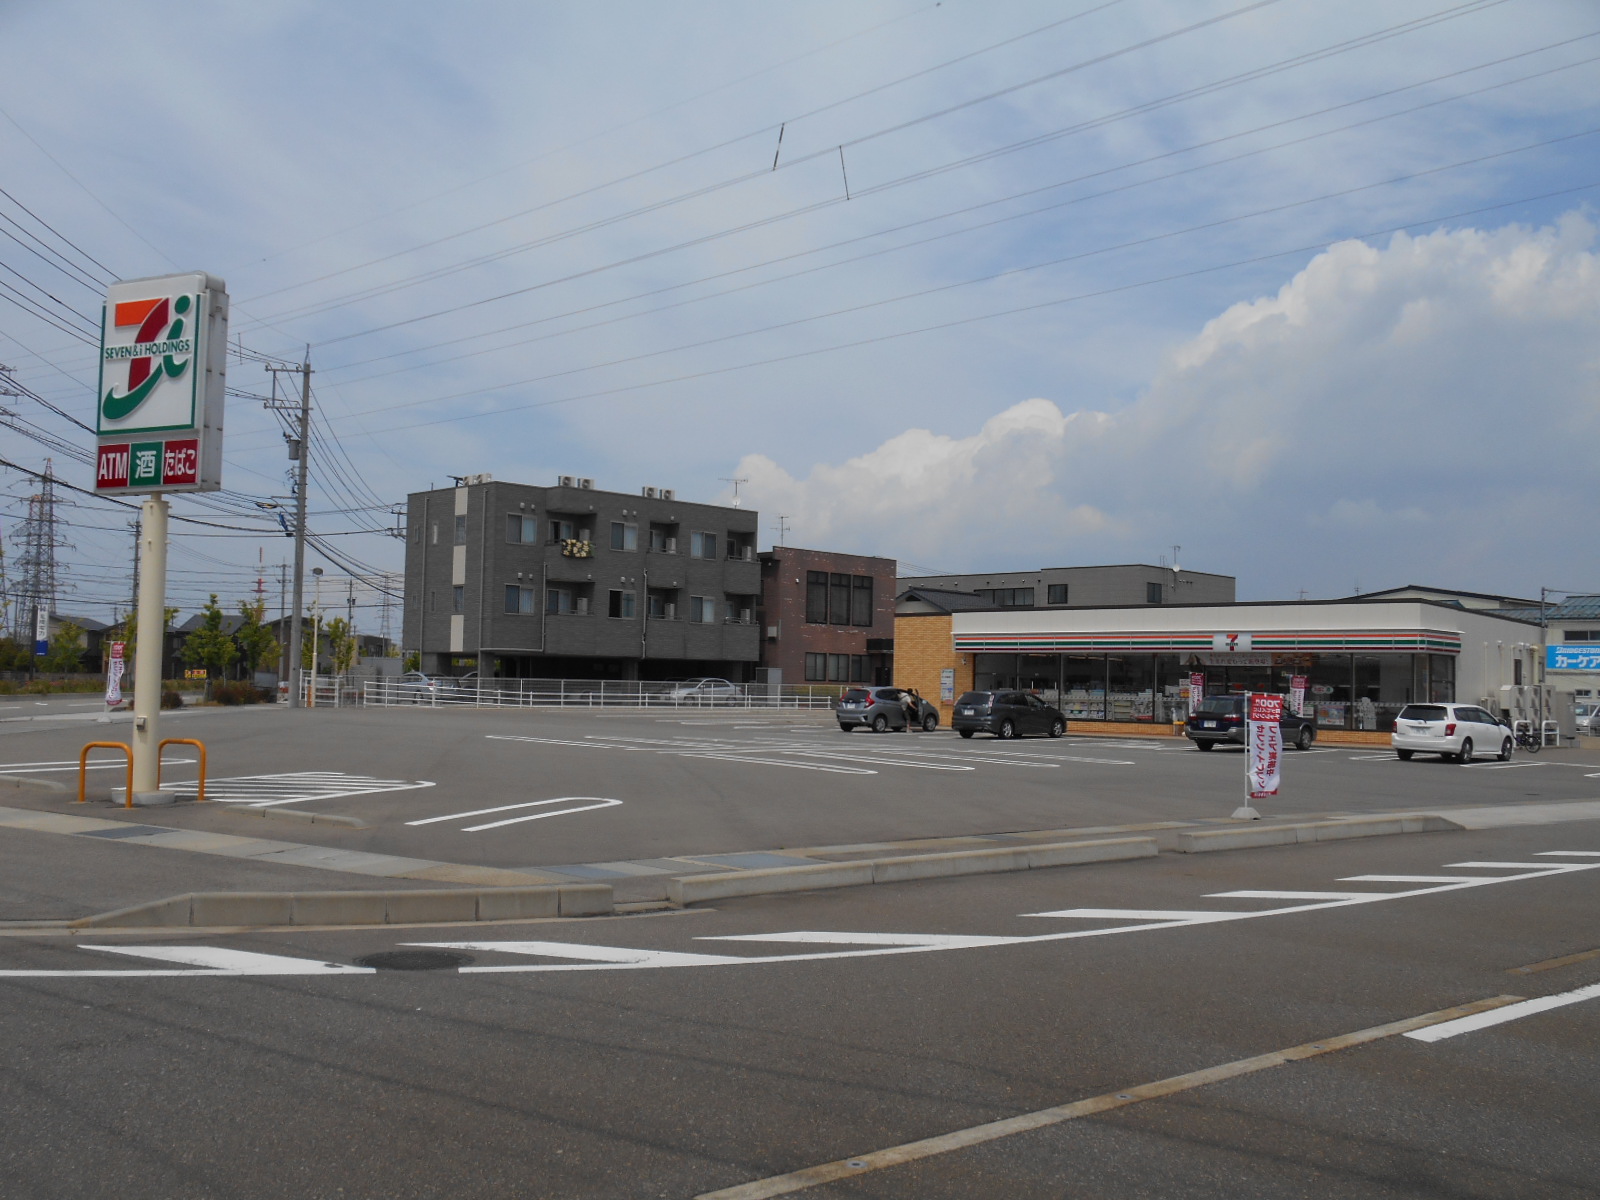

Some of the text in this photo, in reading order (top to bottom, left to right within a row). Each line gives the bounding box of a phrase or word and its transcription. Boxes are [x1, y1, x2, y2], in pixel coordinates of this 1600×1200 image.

[145, 338, 190, 354] HOLDINGS
[98, 451, 128, 480] ATM
[135, 450, 157, 479] 酒
[164, 447, 196, 477] たばこ
[1555, 655, 1600, 668] カーケア
